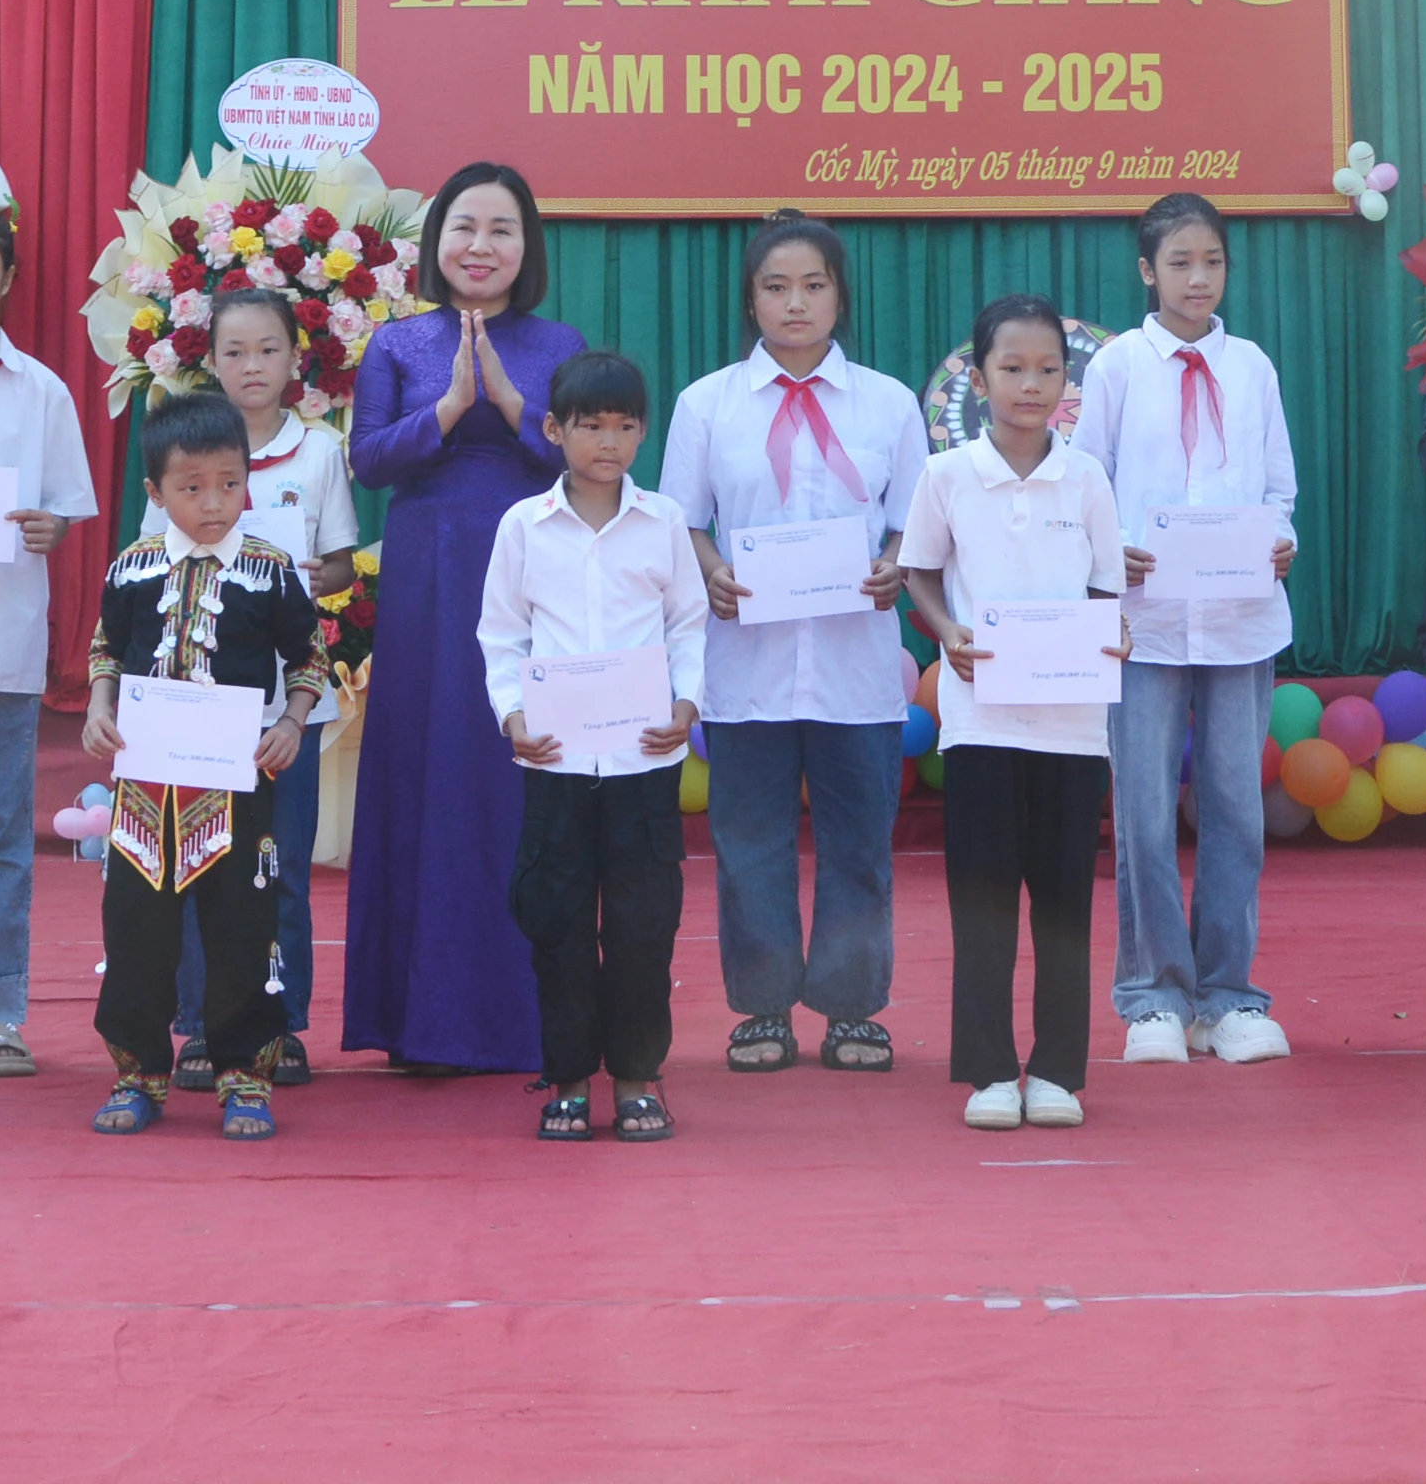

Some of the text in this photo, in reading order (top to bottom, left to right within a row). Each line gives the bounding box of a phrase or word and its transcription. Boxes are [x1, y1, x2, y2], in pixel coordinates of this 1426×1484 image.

[249, 79, 270, 100] TỈNH
[273, 78, 285, 100] ỦY
[293, 86, 318, 101] HĐND
[327, 87, 351, 102] UBND
[530, 42, 663, 113] NĂM
[687, 54, 800, 126] HỌC
[823, 55, 962, 113] 2024
[1024, 53, 1162, 111] 2025
[224, 105, 374, 128] UBMTTQ VIỆT NAM TỈNH LÀO CAI
[248, 131, 292, 150] Chúc
[806, 144, 1240, 190] Cốc Mỳ, ngày 05 tháng 9 năm 2024
